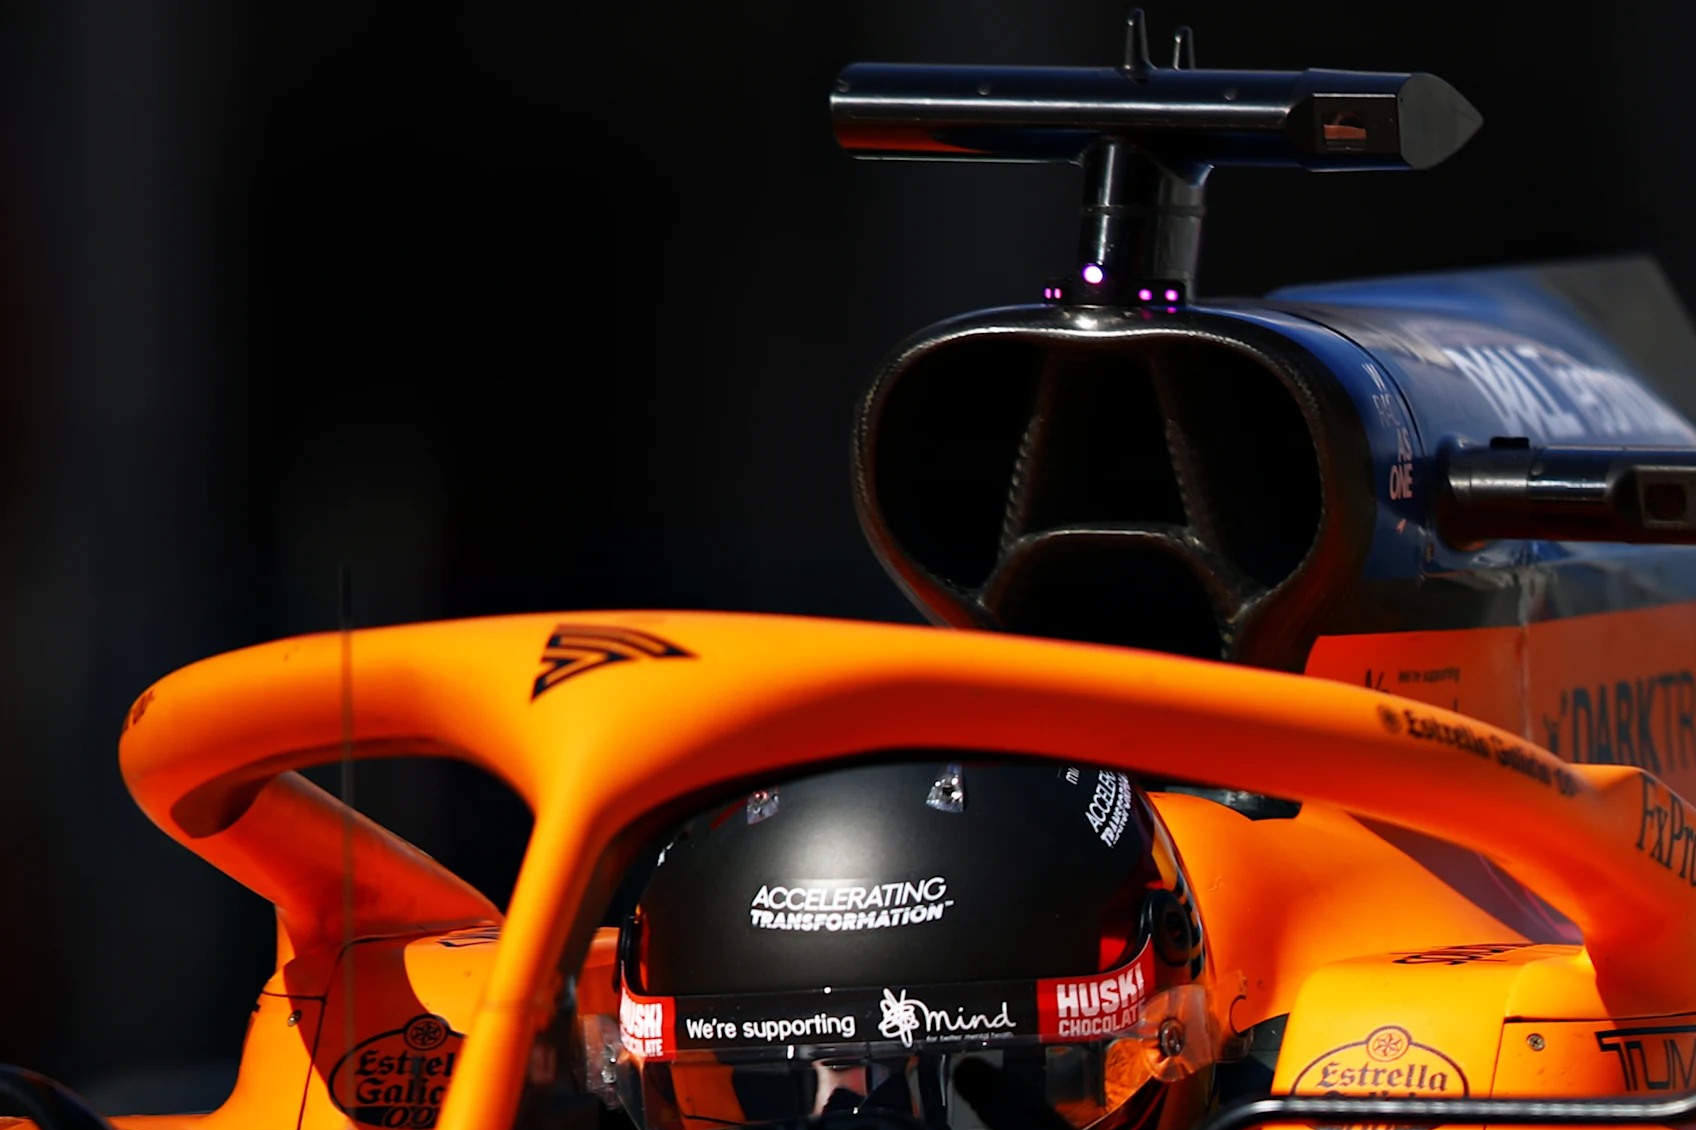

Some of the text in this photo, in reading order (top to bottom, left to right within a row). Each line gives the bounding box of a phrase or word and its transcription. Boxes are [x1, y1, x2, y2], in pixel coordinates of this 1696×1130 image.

[751, 876, 947, 911] ACCELERATING
[750, 902, 945, 932] TRANSFORMATION
[1056, 962, 1145, 1018] HUSKI
[686, 1012, 856, 1042] We're supporting
[355, 1049, 456, 1077] Estrel
[1316, 1062, 1449, 1092] Estrella
[356, 1077, 446, 1105] Galic
